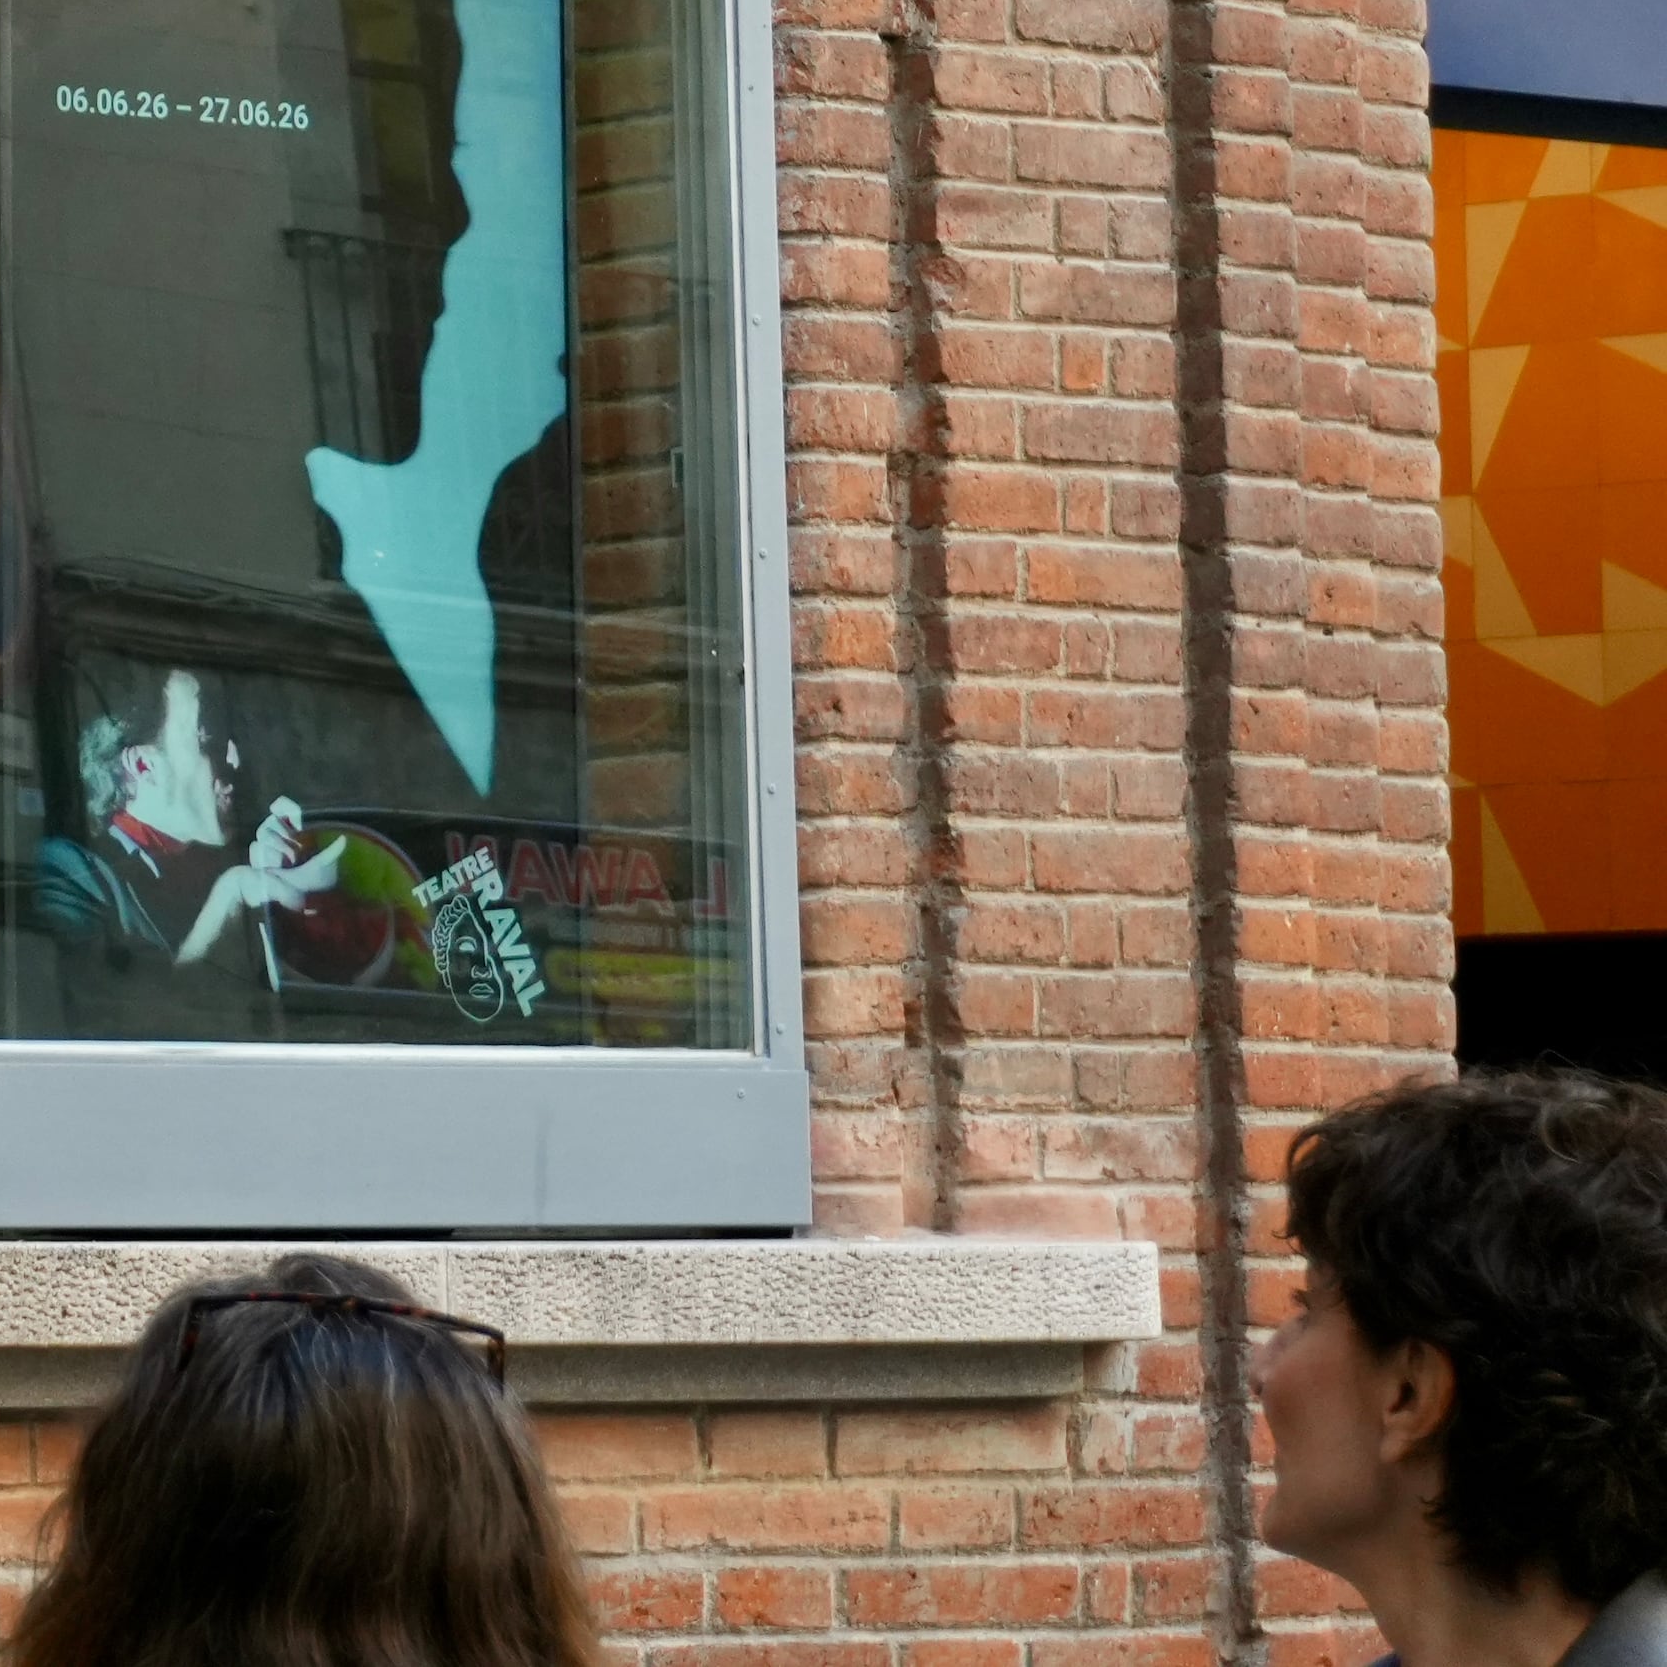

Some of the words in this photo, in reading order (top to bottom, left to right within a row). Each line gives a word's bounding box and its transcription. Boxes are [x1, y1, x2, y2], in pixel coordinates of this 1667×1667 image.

[55, 84, 170, 122] 06.06.26
[199, 94, 311, 133] 27.06.26
[411, 845, 496, 909] TEATRE
[471, 868, 549, 1018] RAVAL
